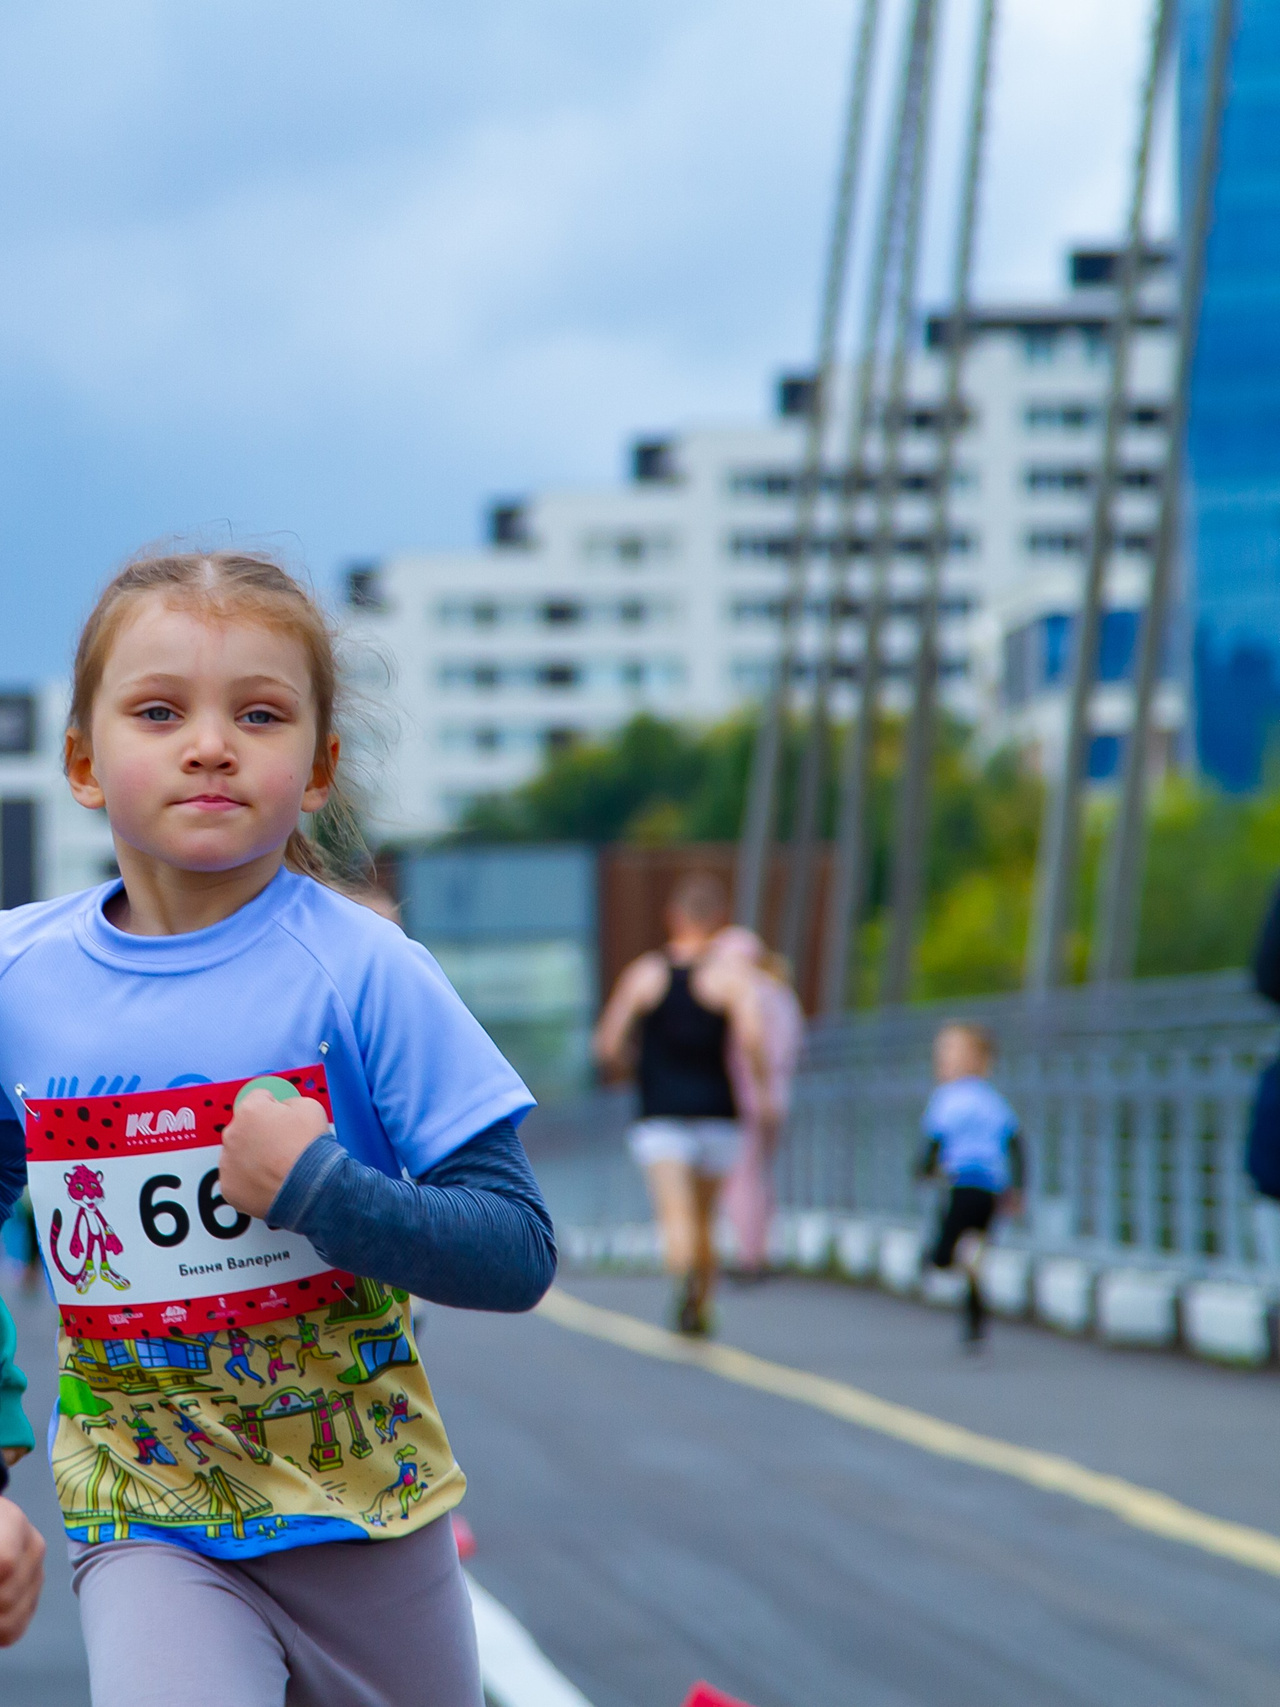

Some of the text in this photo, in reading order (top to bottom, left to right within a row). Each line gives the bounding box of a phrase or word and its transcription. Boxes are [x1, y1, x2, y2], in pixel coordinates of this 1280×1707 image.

[138, 1167, 286, 1248] 66
[178, 1250, 291, 1277] Бизня Валерия
